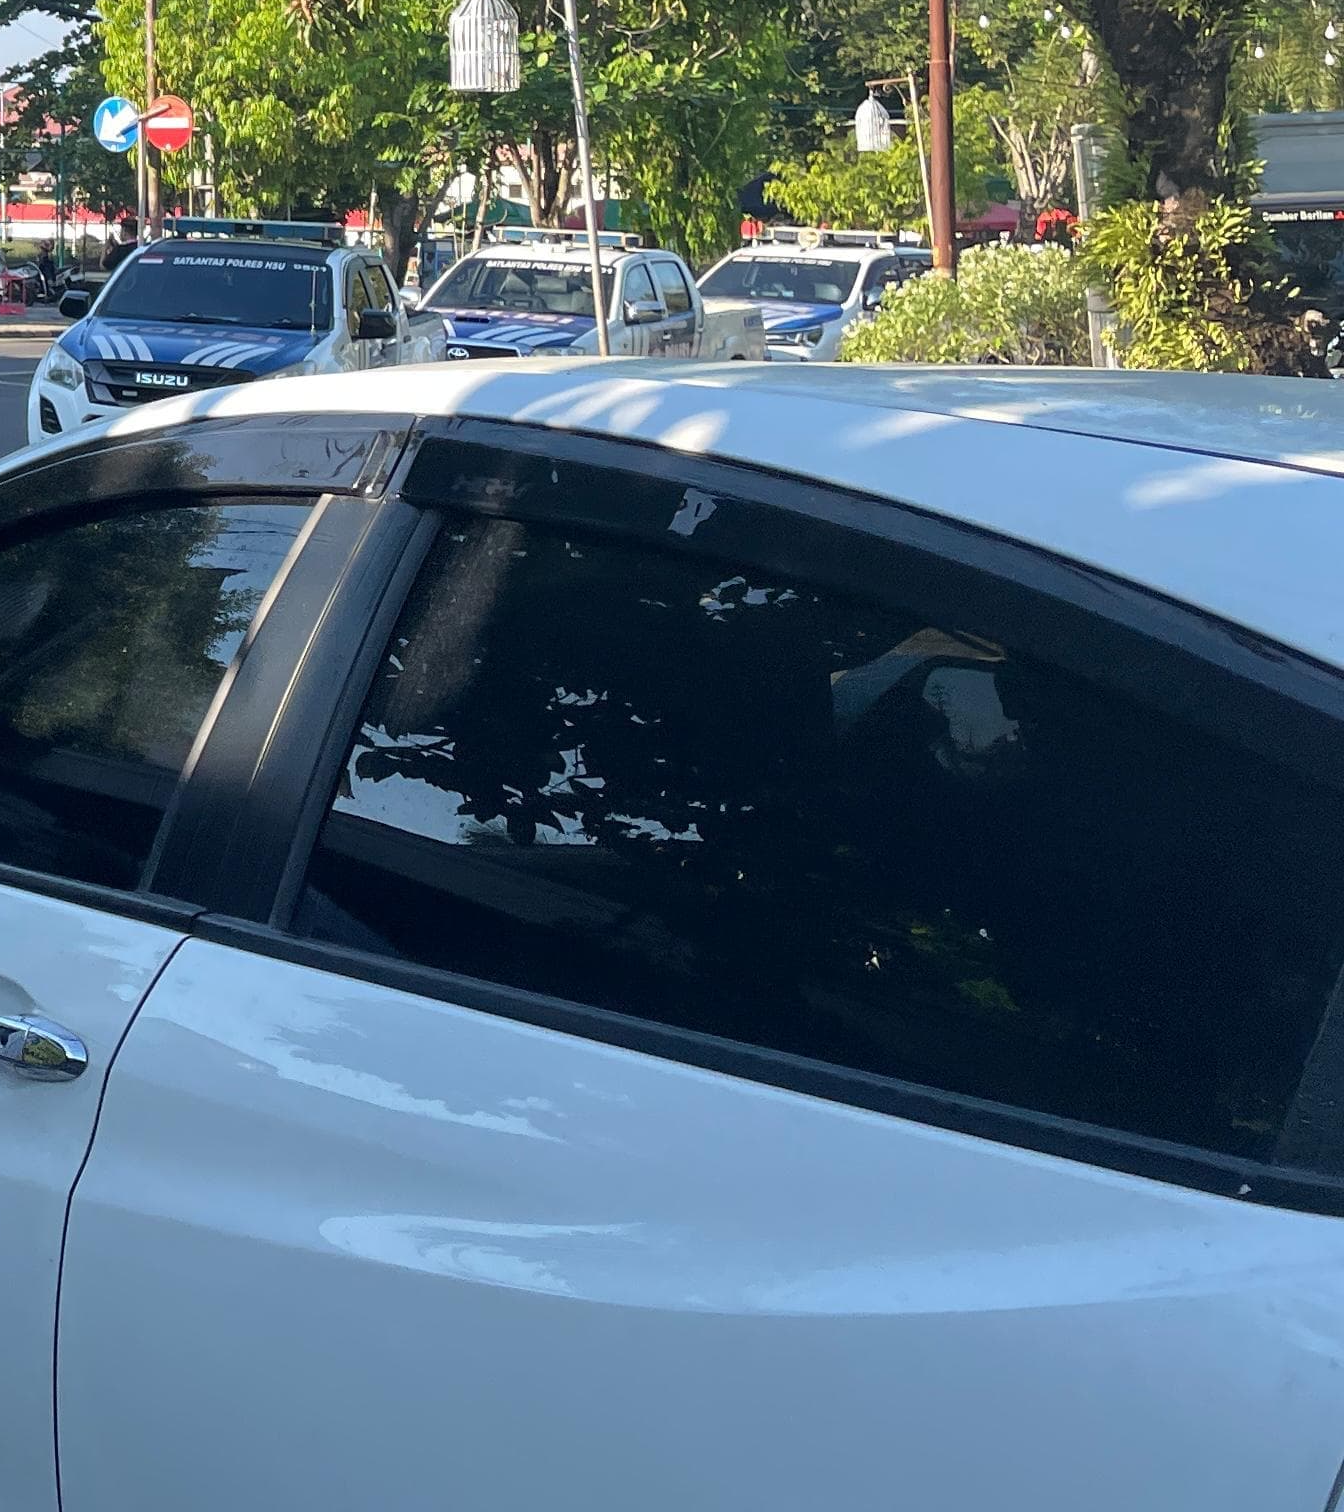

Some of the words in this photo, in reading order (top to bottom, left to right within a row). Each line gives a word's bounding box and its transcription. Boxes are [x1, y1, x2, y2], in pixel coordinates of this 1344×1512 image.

[173, 257, 225, 267] SATLANTAS
[226, 259, 263, 269] POLRES
[264, 261, 286, 271] HSU
[136, 372, 189, 386] ISUZU
